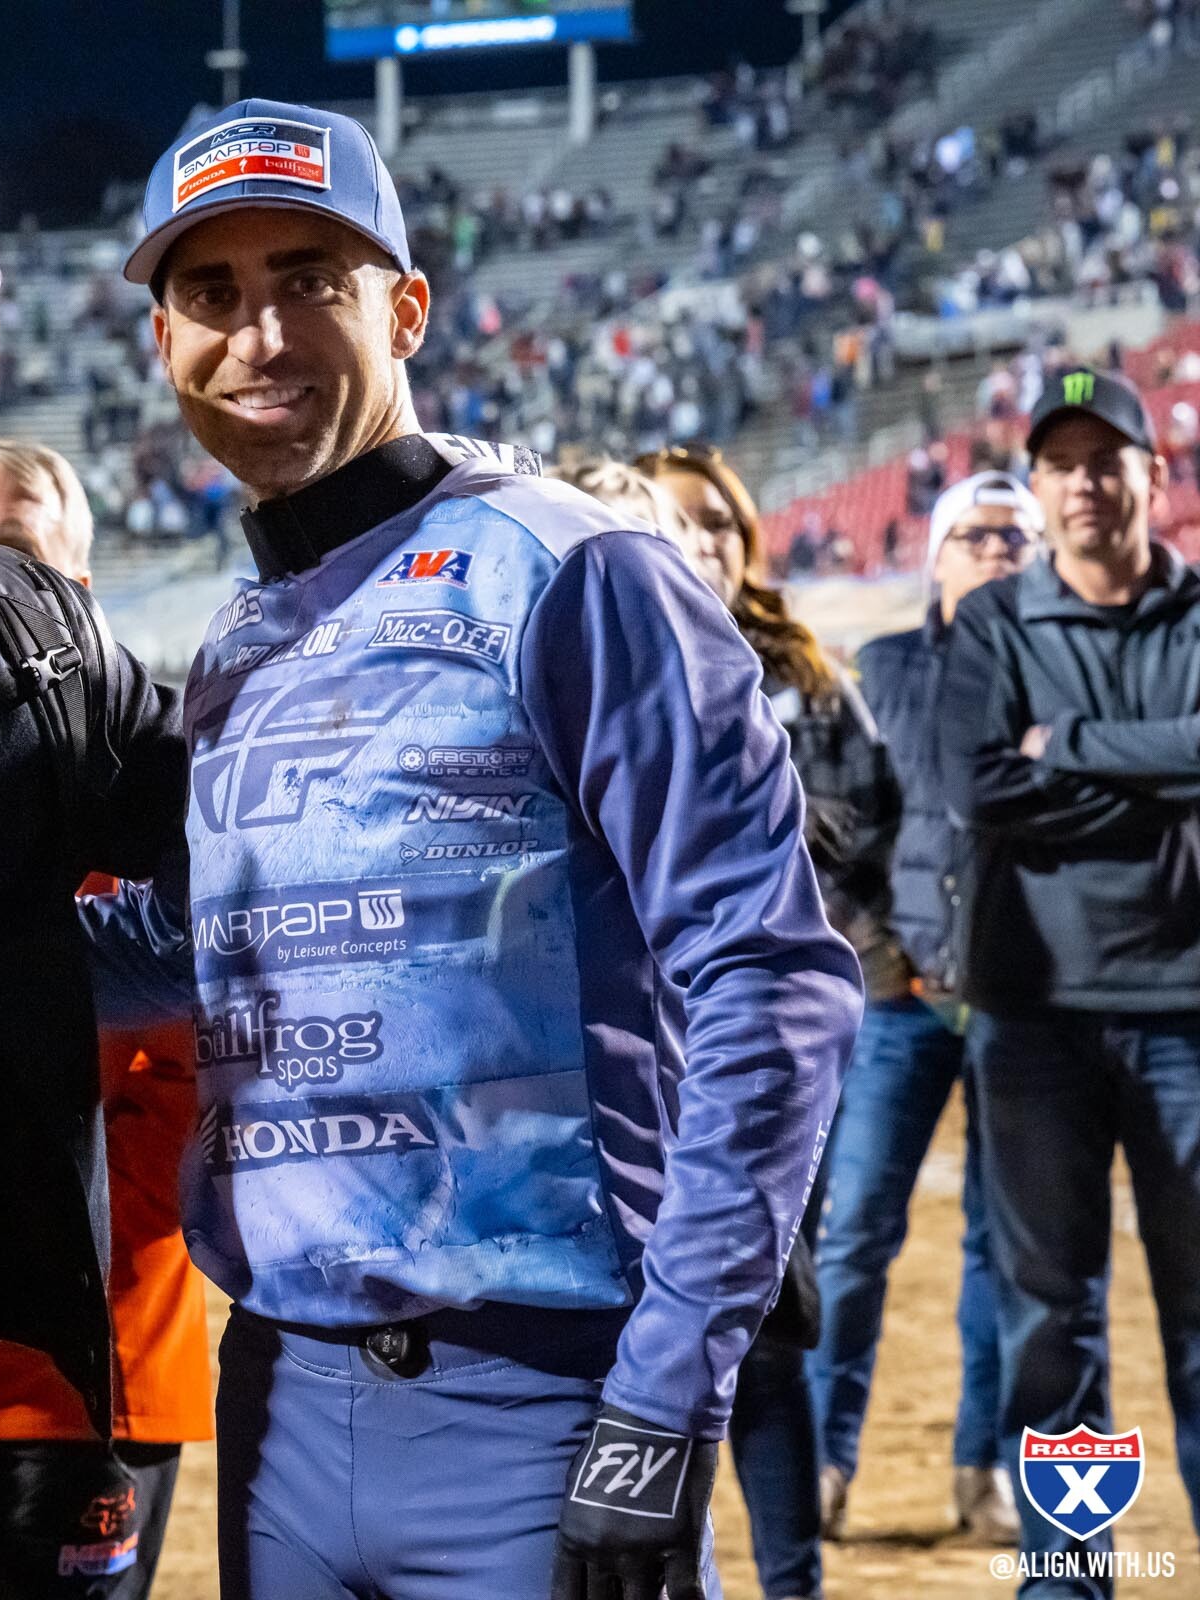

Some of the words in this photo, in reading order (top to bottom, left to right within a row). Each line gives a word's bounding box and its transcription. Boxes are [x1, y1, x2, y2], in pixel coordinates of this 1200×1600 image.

[210, 123, 277, 147] MCR
[183, 140, 292, 178] SMARTOP
[187, 168, 227, 191] HONDA
[377, 549, 474, 585] AMA
[229, 644, 272, 677] RED
[302, 621, 342, 657] OIL
[376, 618, 504, 657] Muc-Off
[430, 750, 532, 767] FACTORY
[430, 767, 528, 776] WRENCH
[405, 795, 533, 822] NISSIN
[423, 840, 538, 860] DUNLOP
[191, 898, 352, 956] MARTOP
[277, 947, 291, 964] by
[293, 943, 338, 959] Leisure
[340, 937, 408, 956] Concepts
[194, 997, 378, 1075] bullfrog
[277, 1055, 338, 1086] spas
[222, 1112, 436, 1163] HONDA
[583, 1442, 677, 1498] FLY
